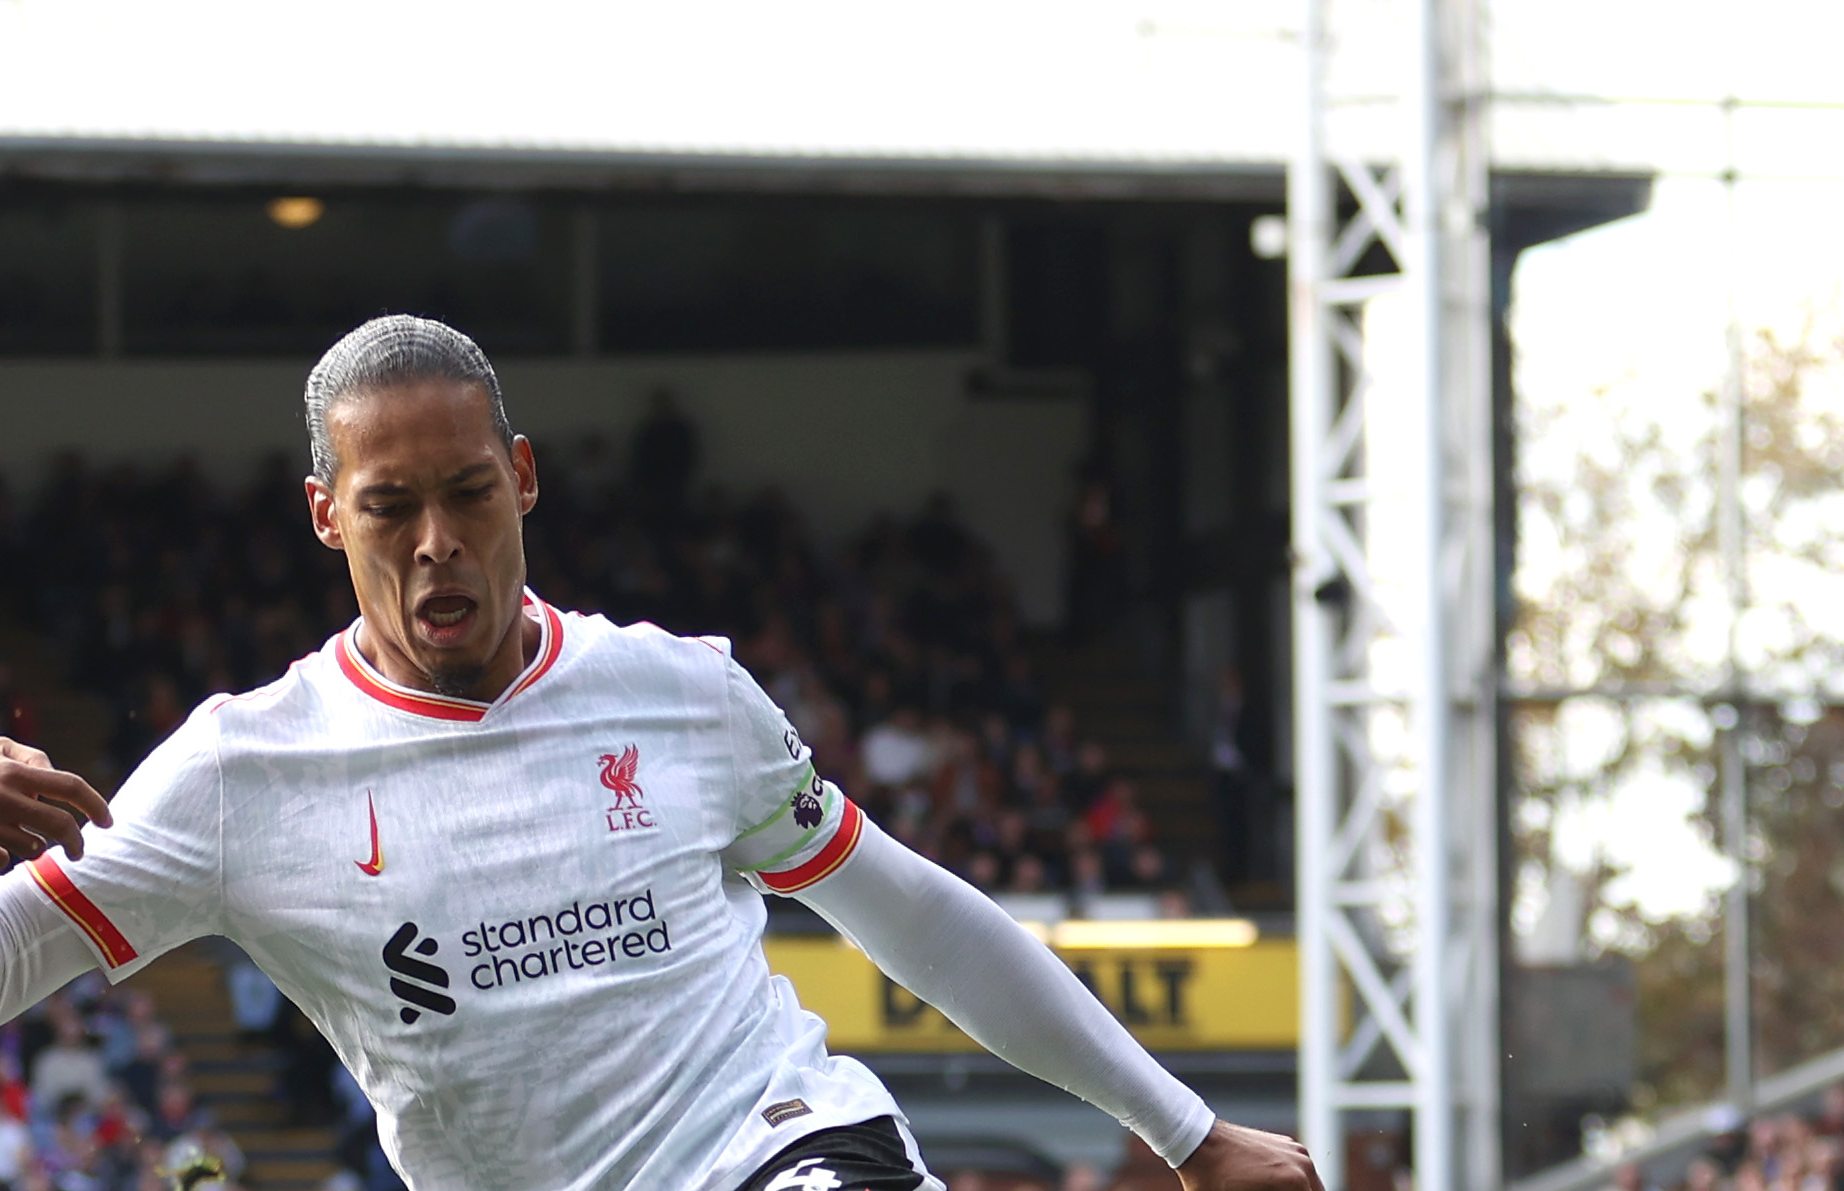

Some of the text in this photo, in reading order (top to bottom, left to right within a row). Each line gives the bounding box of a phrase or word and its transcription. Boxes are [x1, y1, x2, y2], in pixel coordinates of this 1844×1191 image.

[606, 810, 657, 832] L.F.C.
[461, 889, 656, 957] standard
[471, 920, 672, 990] chartered
